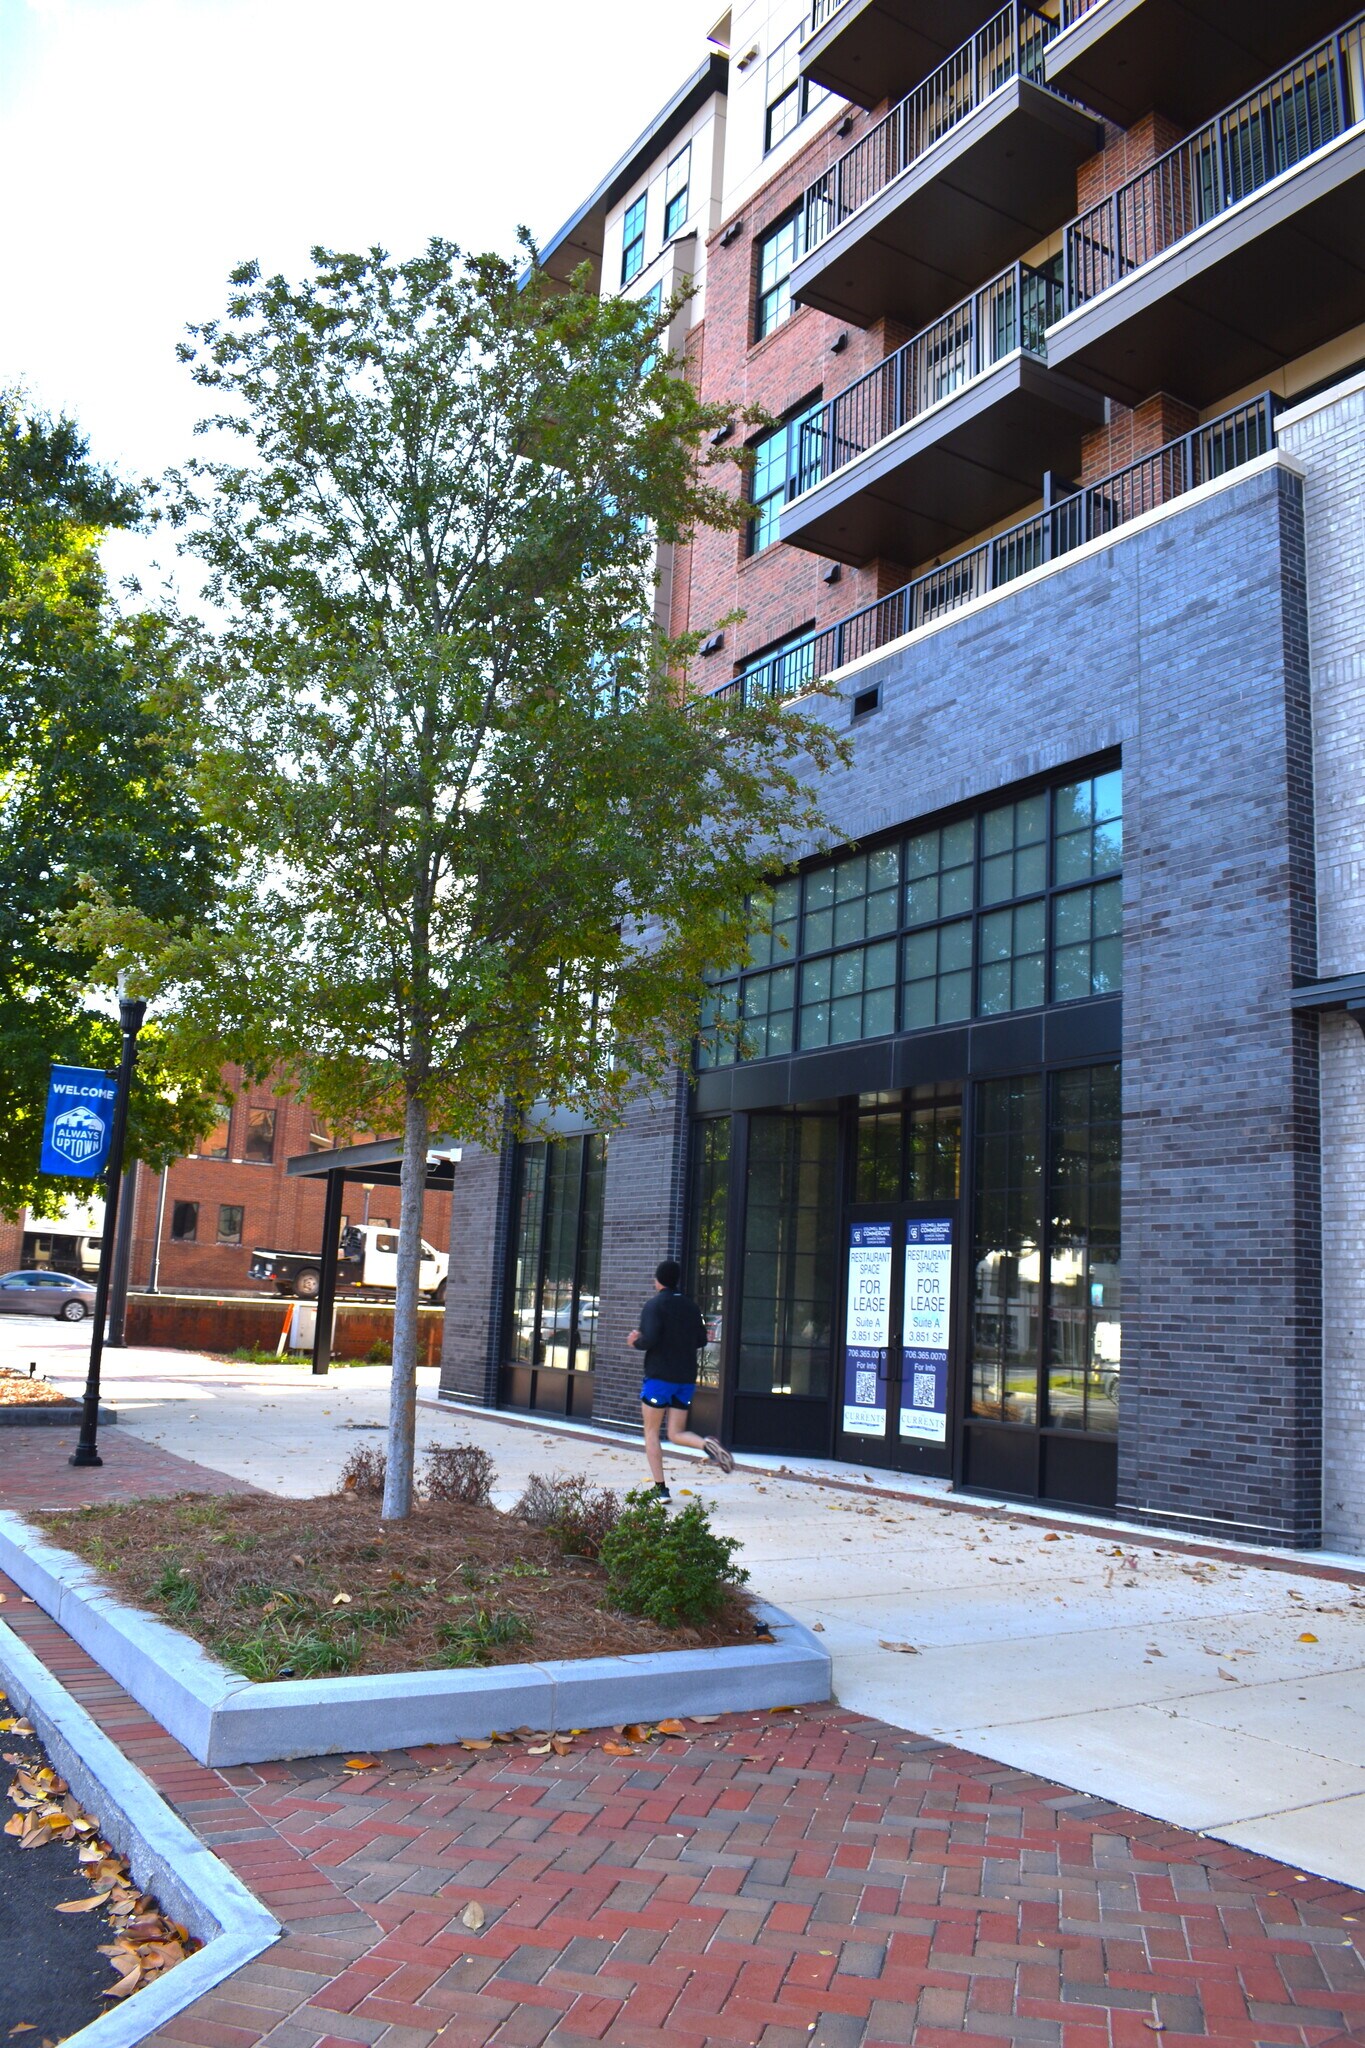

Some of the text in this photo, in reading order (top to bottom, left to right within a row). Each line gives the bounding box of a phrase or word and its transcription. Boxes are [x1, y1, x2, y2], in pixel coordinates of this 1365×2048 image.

[53, 1084, 115, 1099] WELCOME
[58, 1129, 99, 1139] ALWAYS
[56, 1139, 99, 1158] UPTOWN
[851, 1252, 890, 1262] RESTAURANT
[908, 1250, 950, 1261] RESTAURANT
[860, 1264, 880, 1275] SPACE
[917, 1262, 939, 1273] SPACE
[860, 1280, 880, 1294] FOR
[917, 1278, 940, 1294] FOR
[854, 1297, 886, 1312] LEASE
[911, 1296, 945, 1312] LEASE
[856, 1317, 880, 1328] Suite A
[913, 1317, 940, 1328] Suite A
[873, 1332, 884, 1342] SF
[932, 1332, 944, 1343] SF
[905, 1350, 946, 1361] 706.365.0070
[867, 1362, 877, 1370] Info
[926, 1364, 936, 1372] Info
[844, 1412, 884, 1422] CURRENTS
[902, 1414, 944, 1428] CURRENTS
